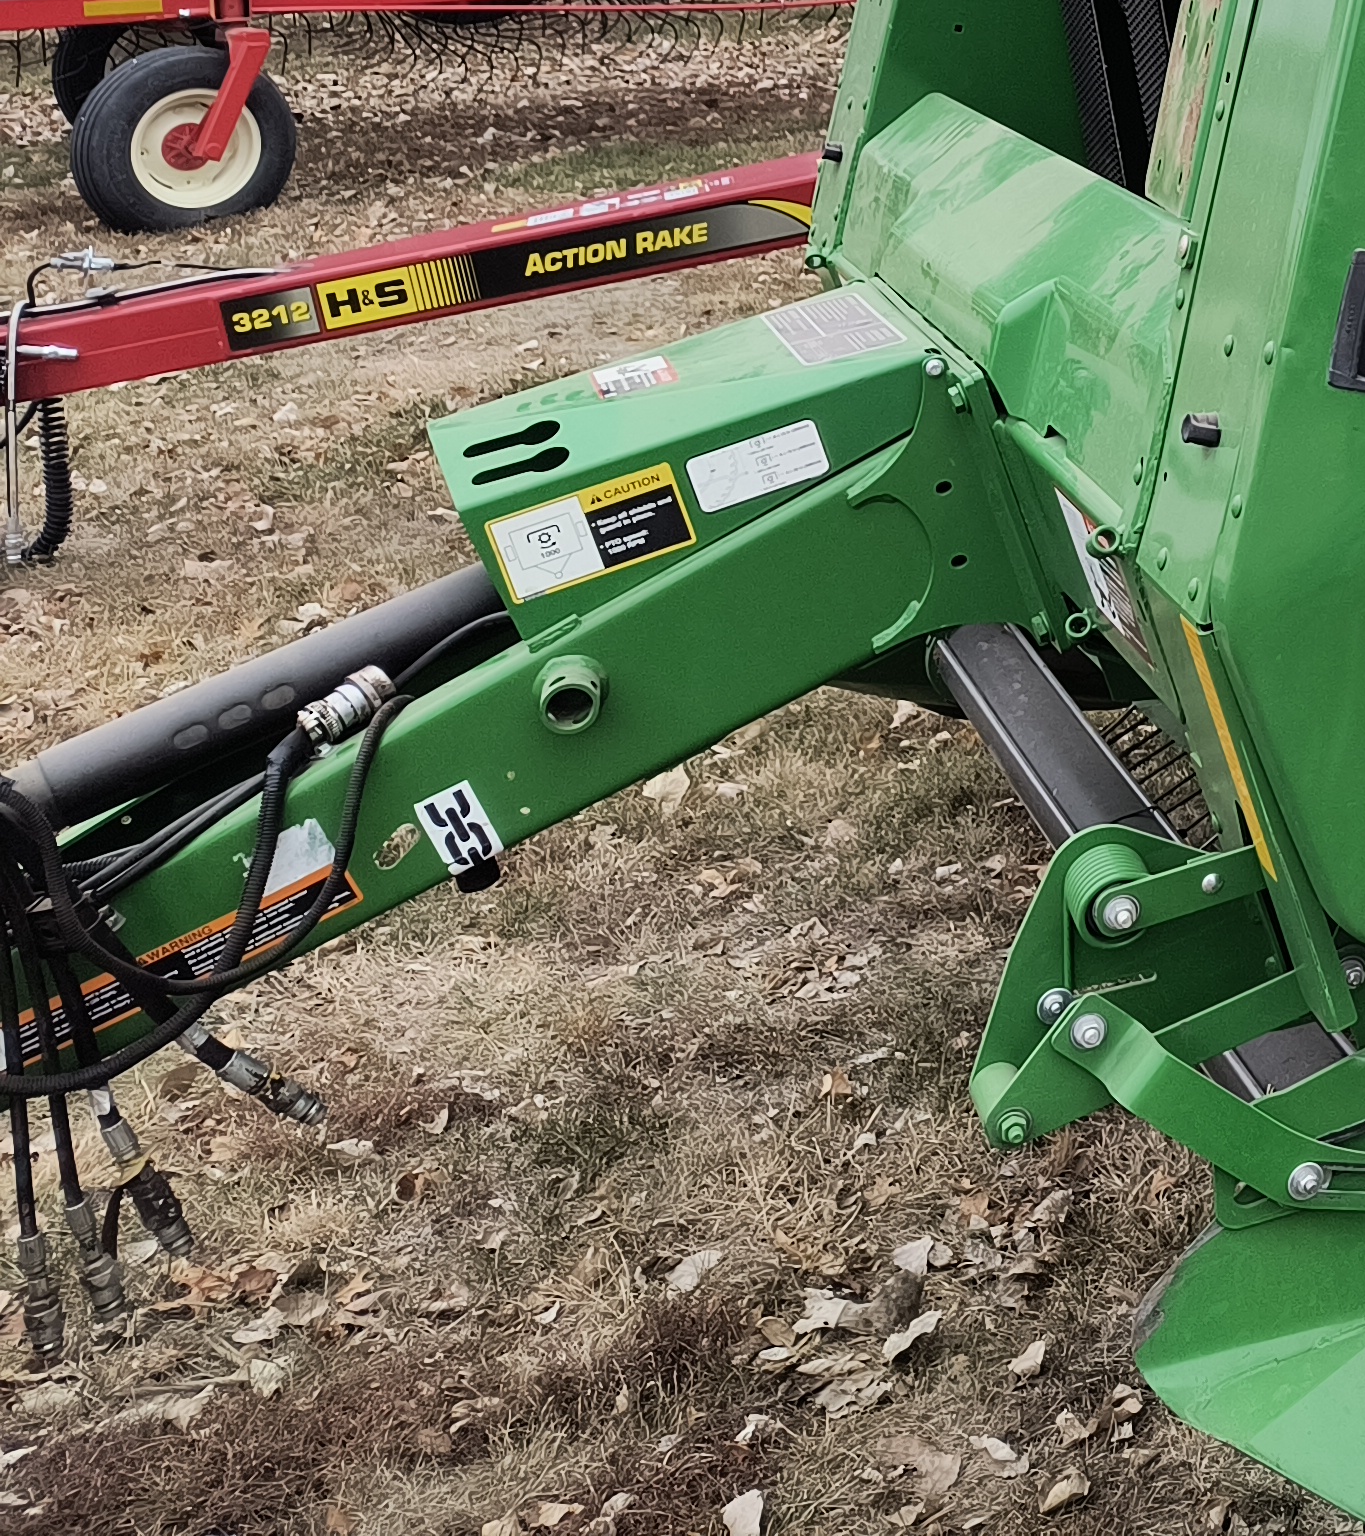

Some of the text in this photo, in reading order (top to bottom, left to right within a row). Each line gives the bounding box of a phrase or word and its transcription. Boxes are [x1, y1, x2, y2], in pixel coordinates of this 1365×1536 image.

[231, 221, 709, 334] 3212 H&S ACTION RAKE
[603, 473, 661, 499] CAUTION
[540, 547, 561, 560] 1000
[144, 924, 213, 964] WARNING
